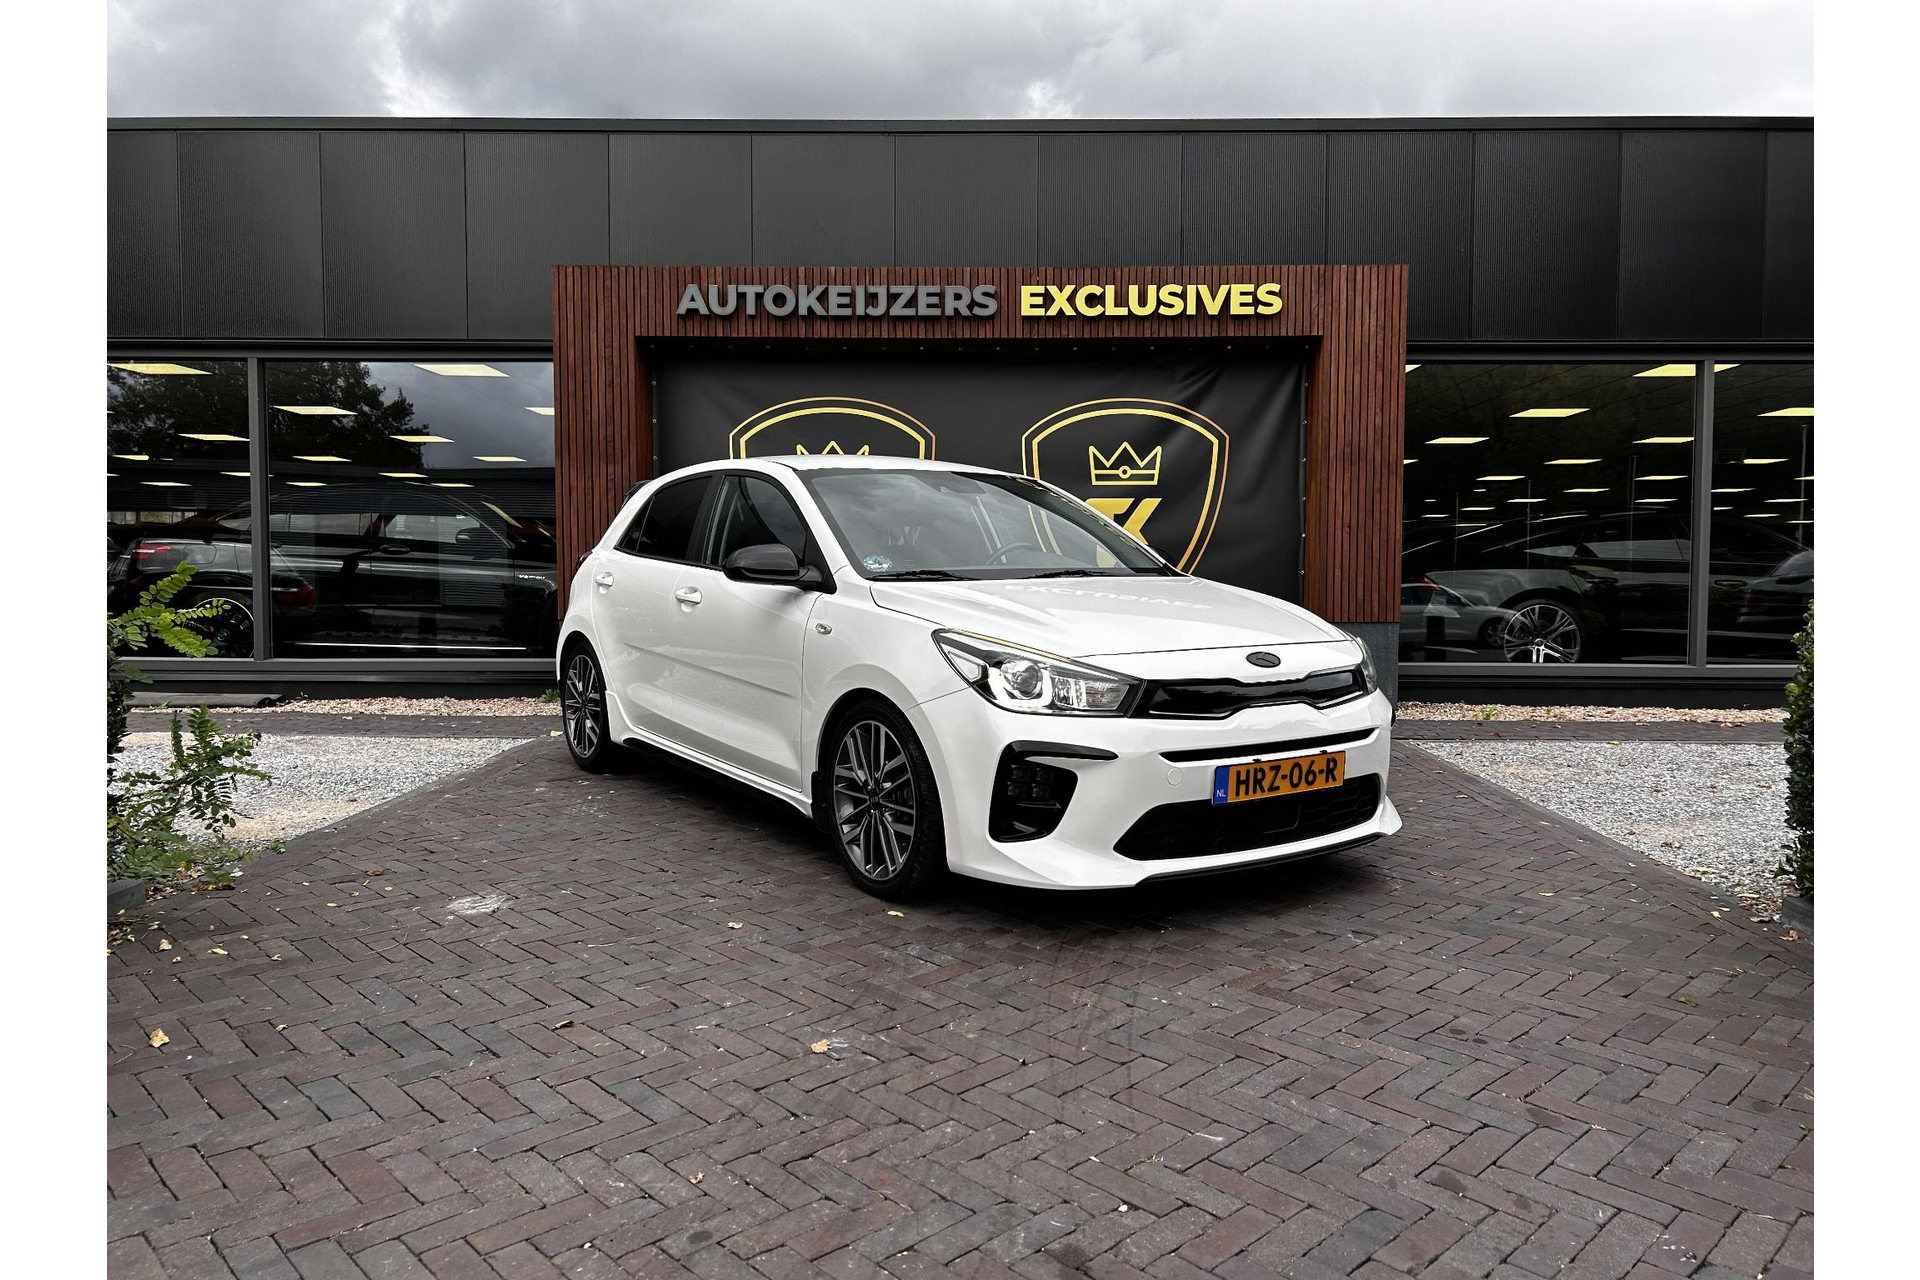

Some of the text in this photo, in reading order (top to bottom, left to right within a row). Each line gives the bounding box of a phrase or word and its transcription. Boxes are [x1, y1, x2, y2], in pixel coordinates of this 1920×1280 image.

[676, 283, 1283, 317] AUTOKEIJZERS EXCLUSIVES
[1216, 788, 1227, 798] NL
[1235, 757, 1338, 797] HRZ-06-R
